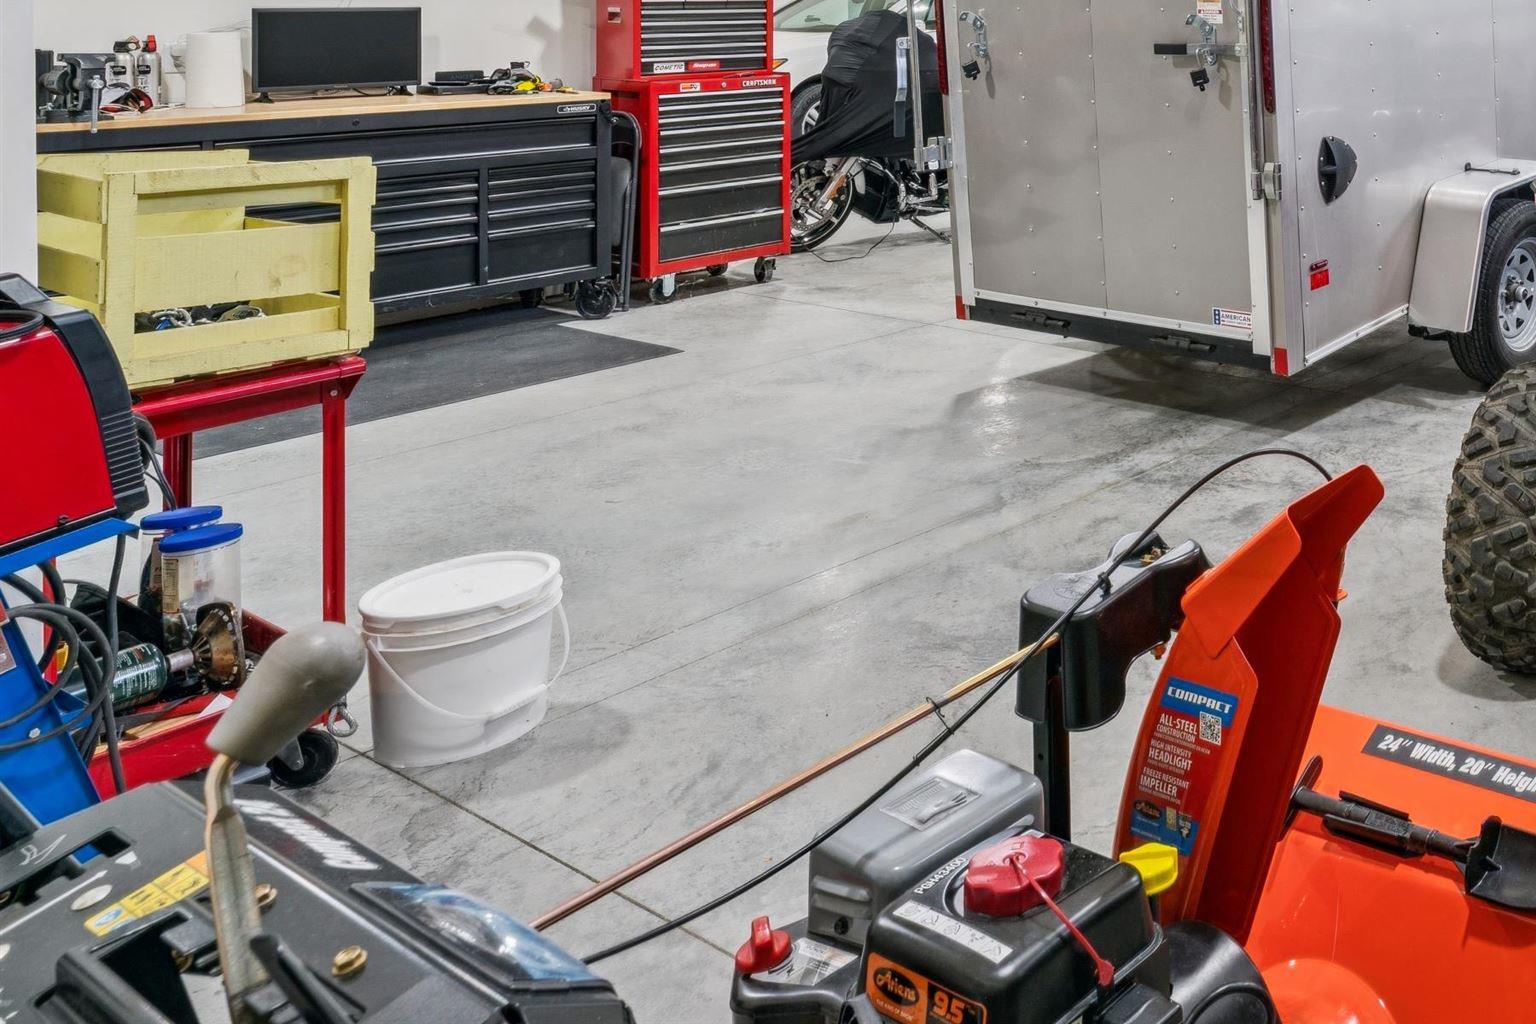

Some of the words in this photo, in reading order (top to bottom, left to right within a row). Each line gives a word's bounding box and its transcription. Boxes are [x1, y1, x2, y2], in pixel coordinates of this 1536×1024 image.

[742, 79, 776, 87] CRAFTSMAN
[1167, 686, 1233, 714] COMPACT
[1156, 724, 1196, 743] CONSTRUCTION
[1159, 713, 1198, 735] ALL-STEEL
[1148, 747, 1193, 772] HEADLIGHT
[1409, 742, 1457, 771] Width,
[1140, 774, 1178, 797] IMPELLER
[876, 970, 916, 1002] Ariens
